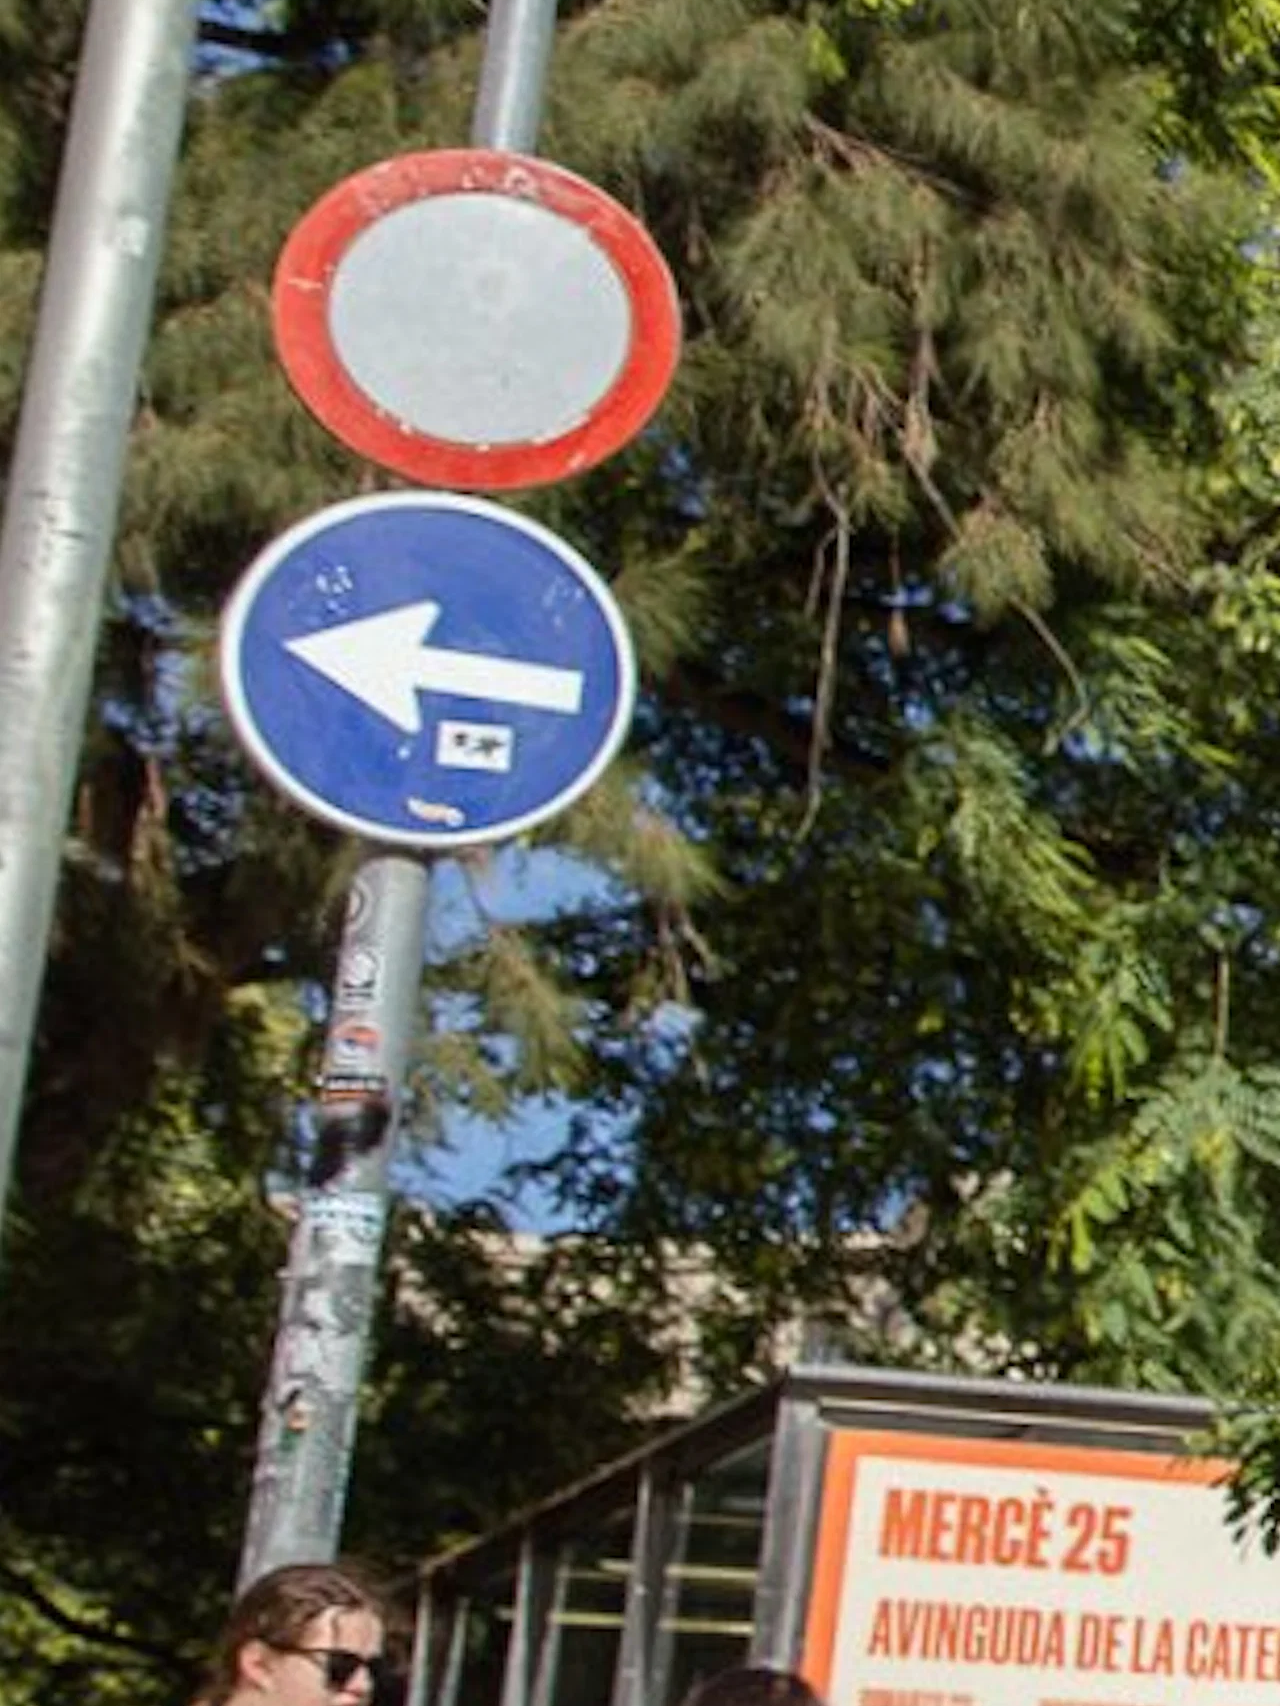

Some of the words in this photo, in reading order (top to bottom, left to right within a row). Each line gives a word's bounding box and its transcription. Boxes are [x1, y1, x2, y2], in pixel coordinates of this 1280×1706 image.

[879, 1486, 1054, 1569] MERCÈ
[1061, 1502, 1133, 1575] 25
[867, 1597, 1065, 1669] AVINGUDA
[1075, 1611, 1127, 1673] DE
[1131, 1617, 1174, 1676] LA
